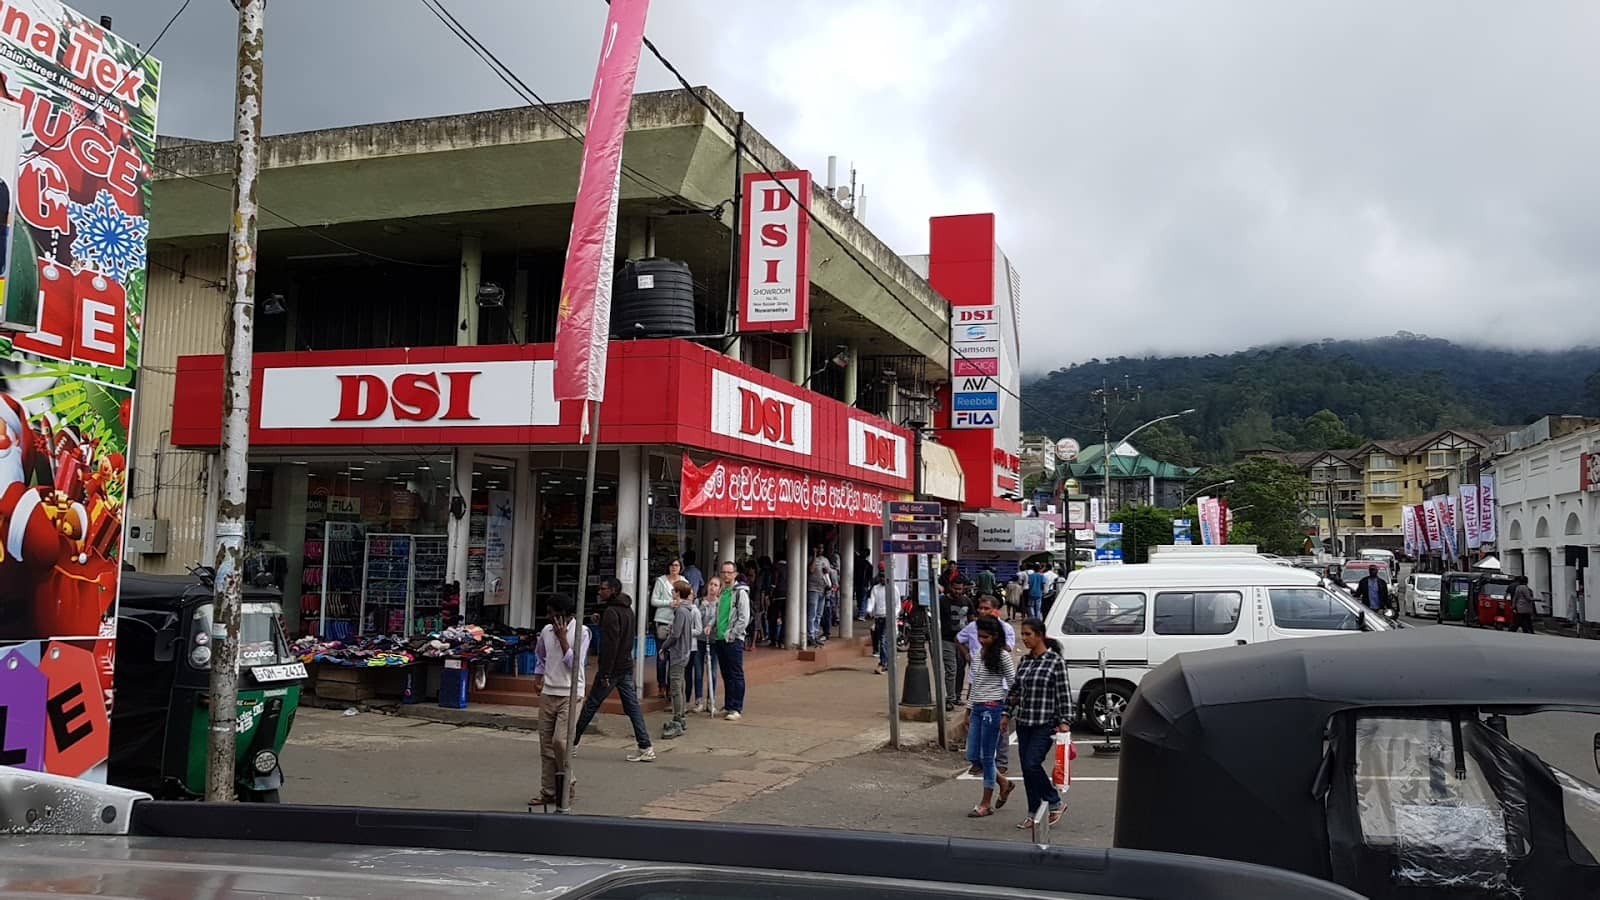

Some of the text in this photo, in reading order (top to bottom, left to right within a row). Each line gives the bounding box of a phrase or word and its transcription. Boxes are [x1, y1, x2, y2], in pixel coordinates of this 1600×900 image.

[0, 0, 142, 104] na Tex
[25, 57, 57, 81] Street
[60, 76, 96, 100] Nuwara
[98, 95, 120, 114] Eliya
[760, 188, 793, 284] DSI
[960, 310, 993, 321] DSI
[958, 346, 995, 354] samsons
[330, 371, 482, 421] DSI
[957, 397, 994, 407] Reebok
[738, 387, 795, 446] DSI
[957, 412, 994, 425] FILA
[864, 430, 897, 472] DSI
[331, 500, 354, 512] FILA
[1428, 508, 1440, 542] MELWA
